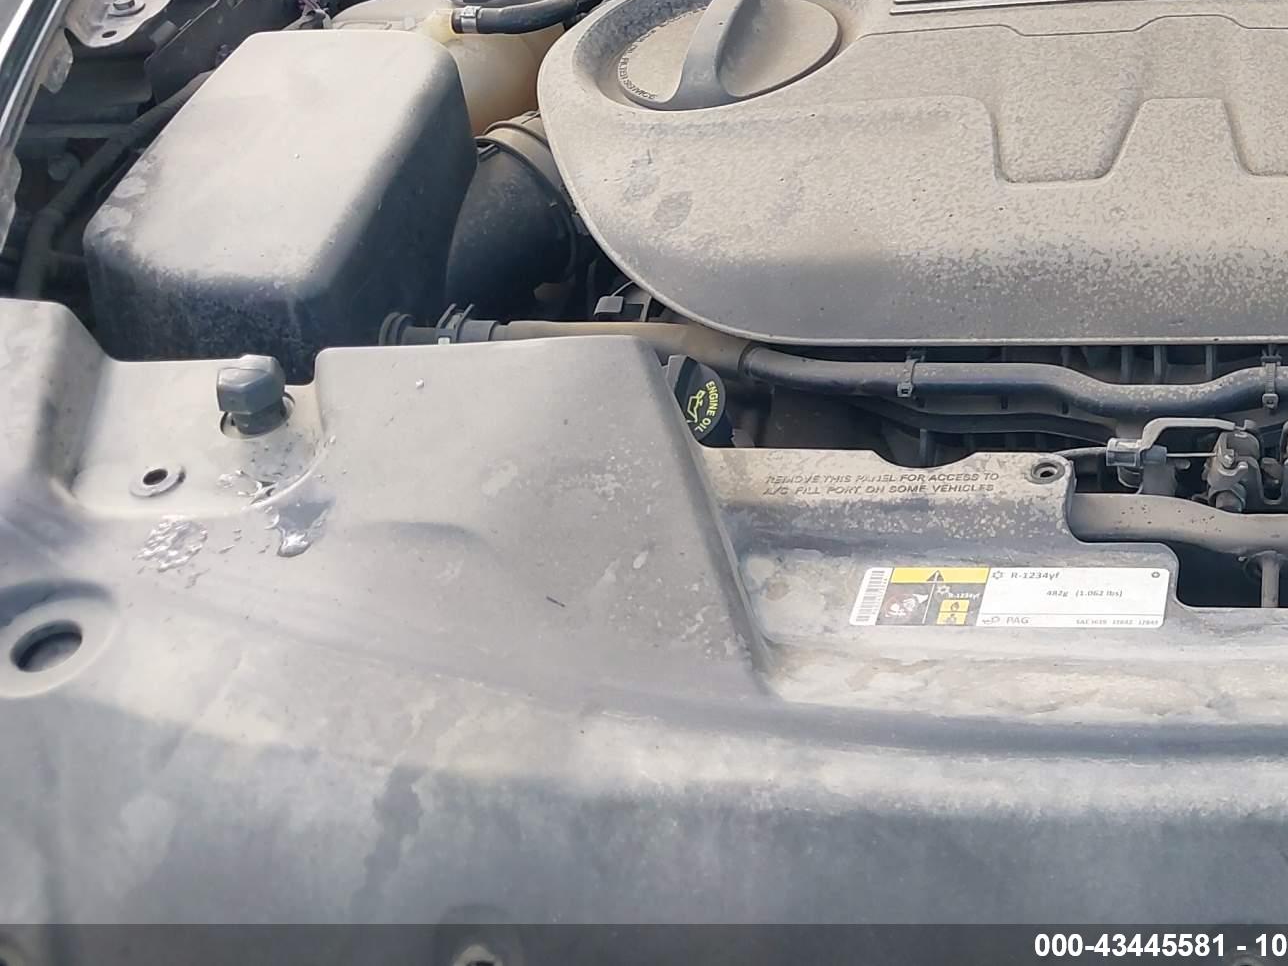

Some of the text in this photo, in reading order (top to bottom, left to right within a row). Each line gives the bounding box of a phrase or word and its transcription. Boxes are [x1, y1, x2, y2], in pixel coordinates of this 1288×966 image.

[694, 380, 719, 433] ENGINE OIL
[765, 472, 1000, 484] REMOVE THIS PANEL FOR ACCESS TO
[794, 485, 821, 495] FILL
[826, 485, 861, 495] PORT
[866, 485, 885, 494] ON
[889, 484, 927, 494] SOME
[931, 483, 995, 493] VEHICLES
[1010, 571, 1061, 581] R-1234yf
[1006, 616, 1030, 625] PAG
